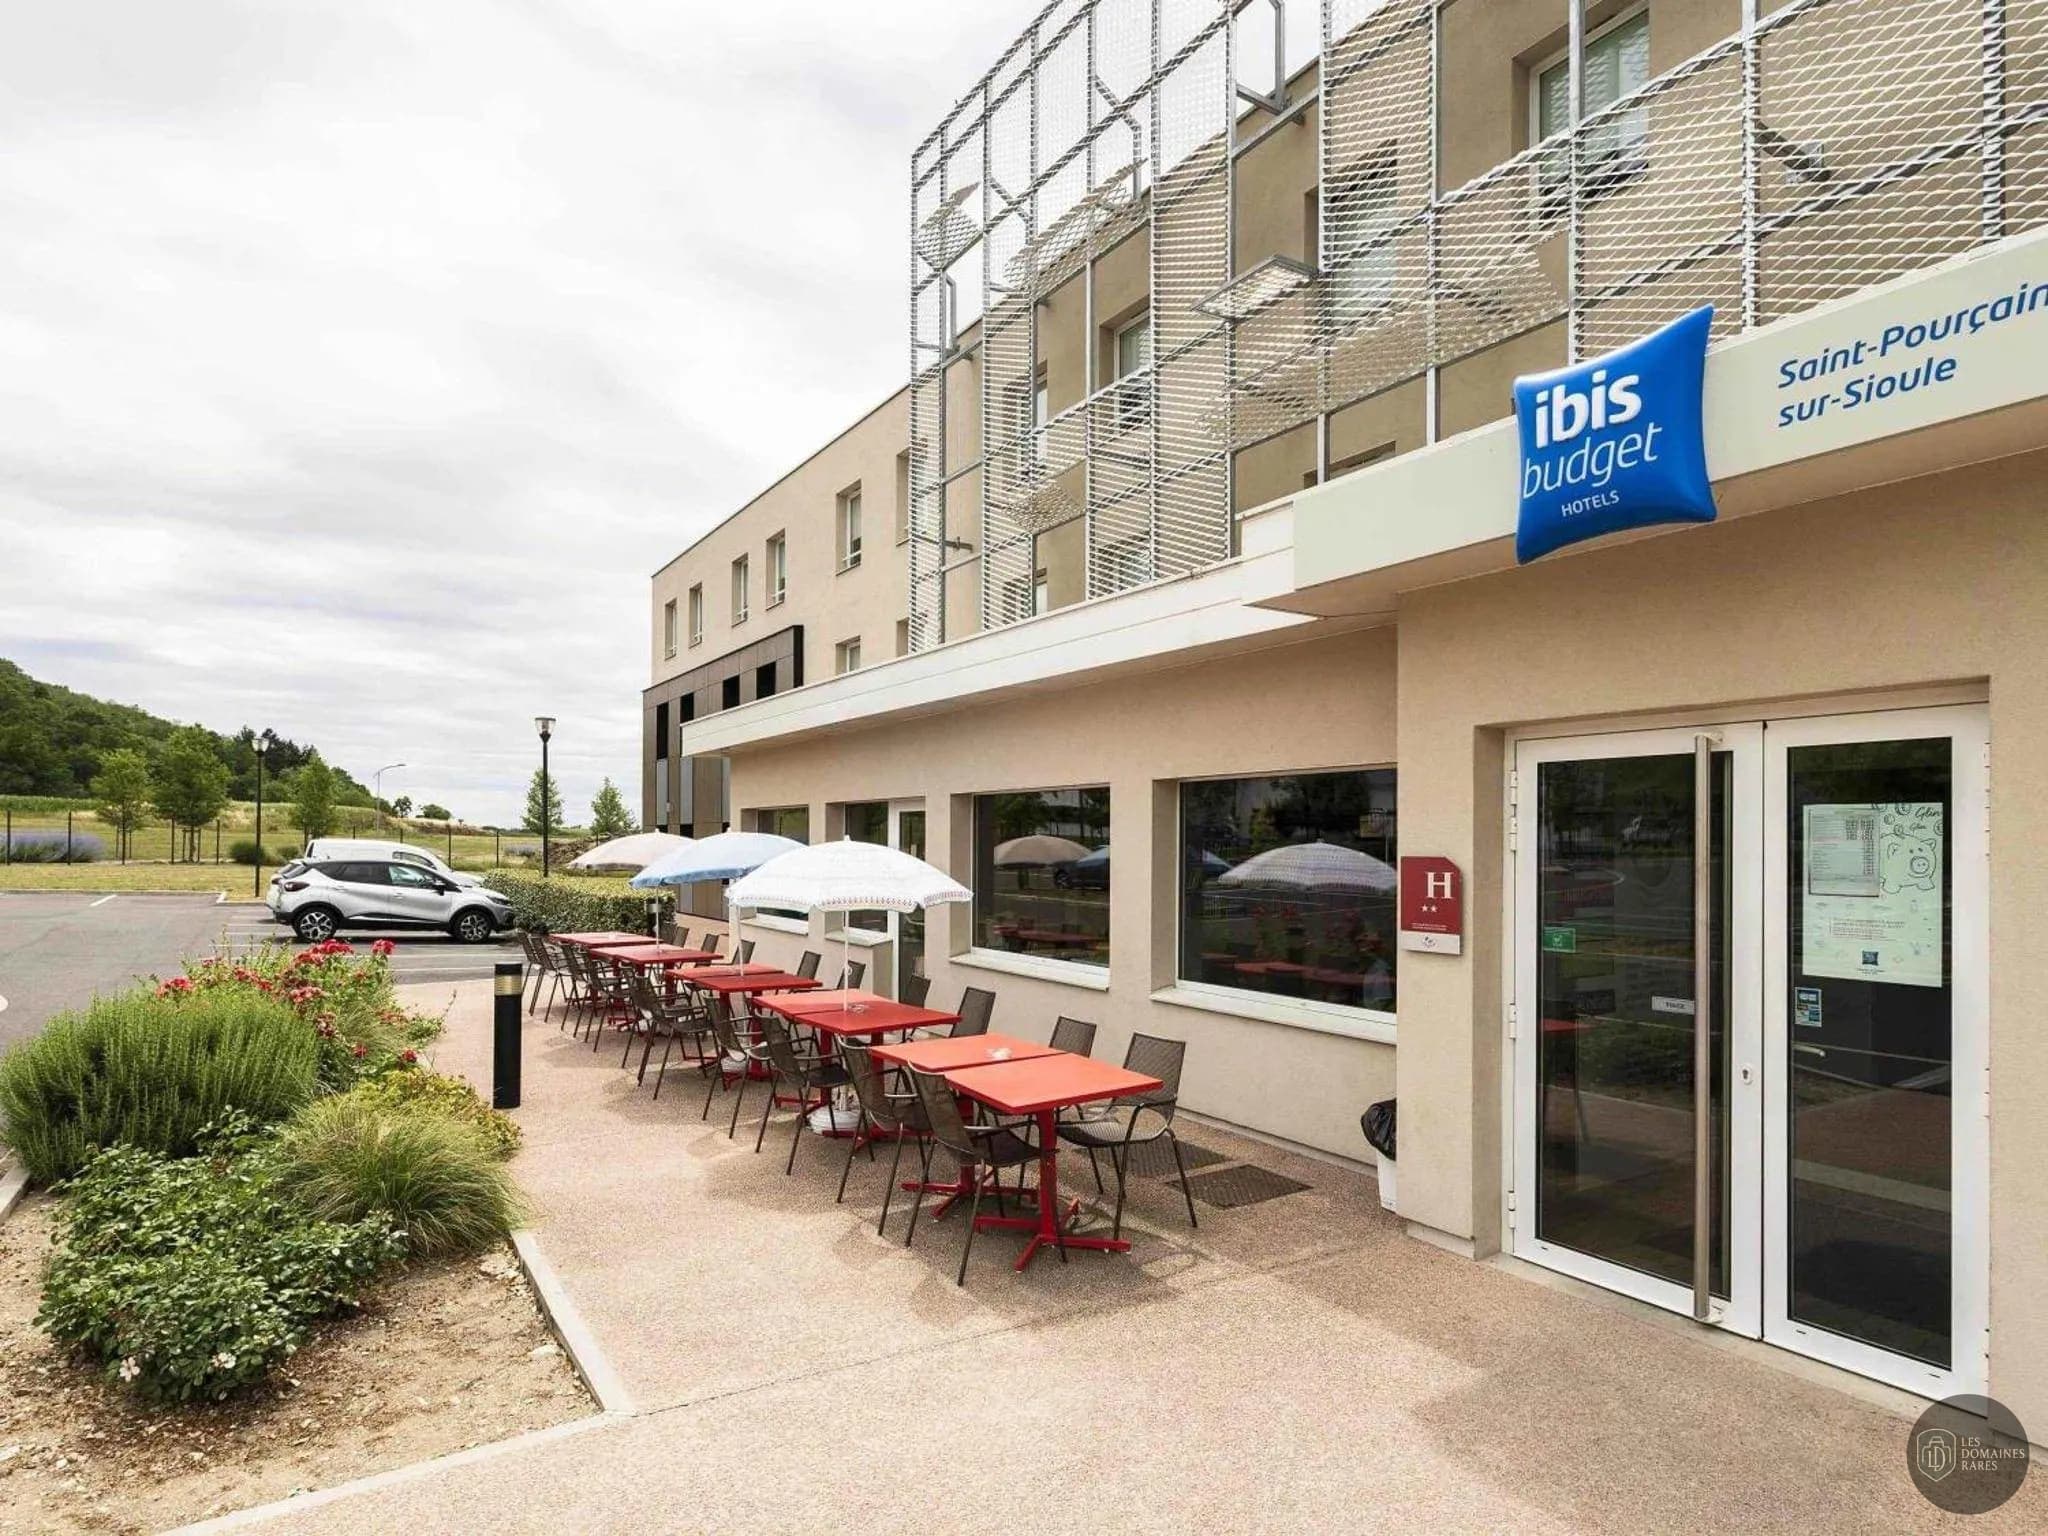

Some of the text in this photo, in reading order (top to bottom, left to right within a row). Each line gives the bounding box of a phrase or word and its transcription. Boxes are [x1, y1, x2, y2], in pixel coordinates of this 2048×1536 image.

[1778, 283, 2048, 388] Saint-Pourçain
[1535, 369, 1642, 449] ibis
[1778, 357, 1957, 427] sur-Sioule
[1523, 422, 1663, 499] budget
[1561, 490, 1620, 517] HOTELS
[1425, 871, 1454, 899] H
